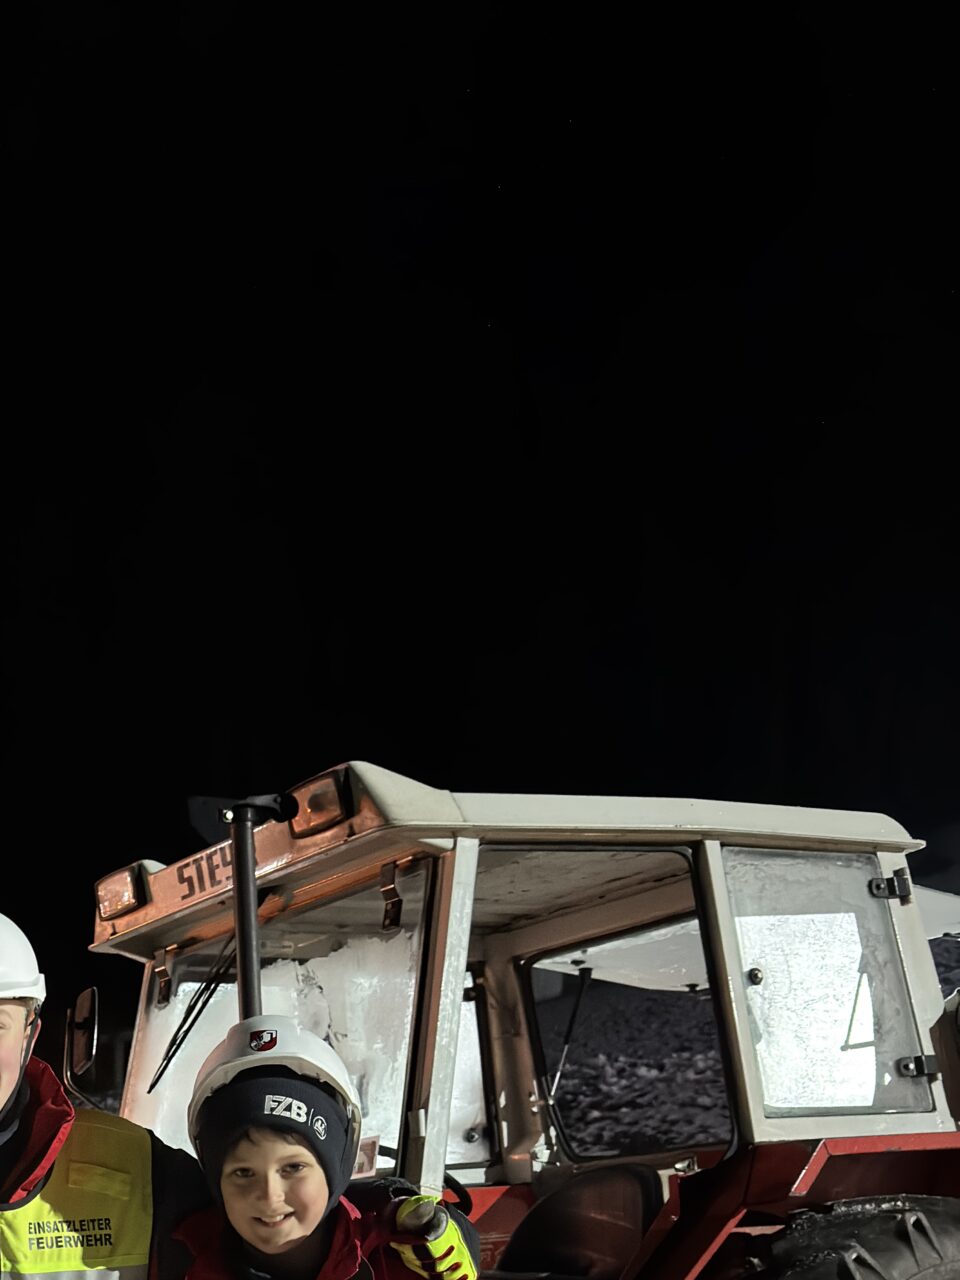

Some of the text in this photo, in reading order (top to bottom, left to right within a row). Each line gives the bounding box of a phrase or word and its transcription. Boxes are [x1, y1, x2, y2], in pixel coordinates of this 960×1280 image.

[176, 843, 233, 901] STEY
[263, 1094, 308, 1123] FZB
[28, 1218, 111, 1235] EINSATZLEITER
[28, 1234, 113, 1251] FEUERWEHR
